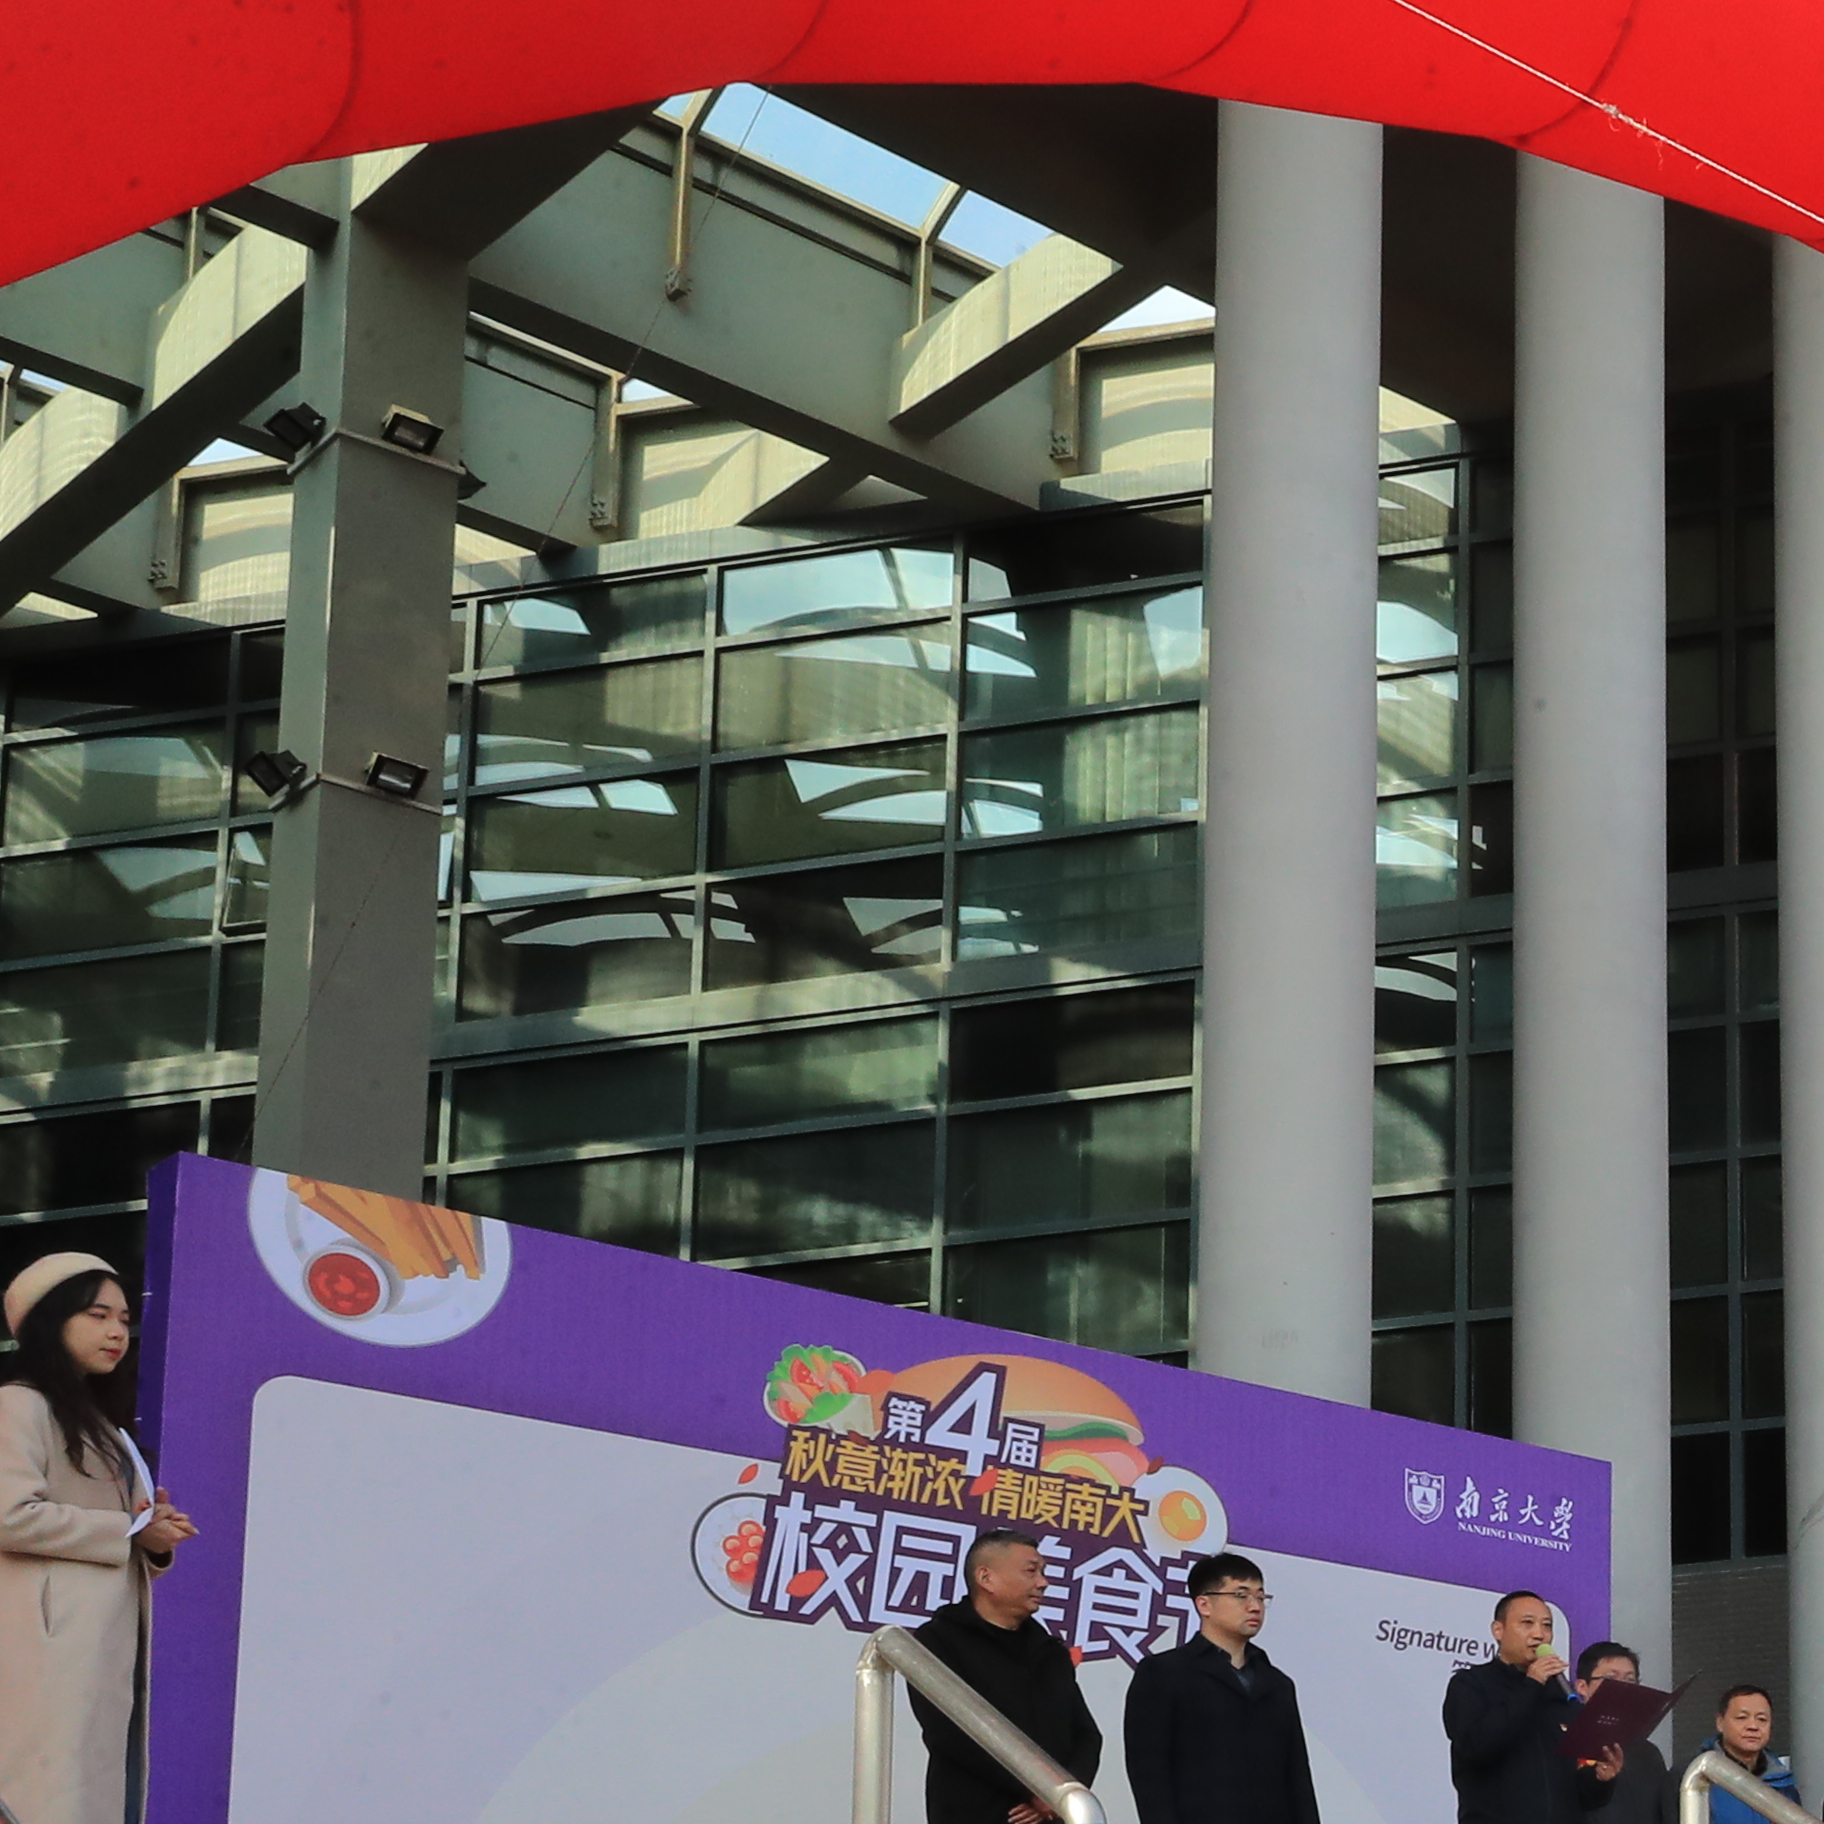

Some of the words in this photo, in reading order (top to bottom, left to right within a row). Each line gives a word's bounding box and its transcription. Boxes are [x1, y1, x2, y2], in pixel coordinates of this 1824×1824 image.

[885, 1371, 1042, 1477] 第4届
[785, 1429, 967, 1511] 秋意渐浓
[980, 1463, 1149, 1545] 情暖南大
[1457, 1520, 1507, 1541] NANJING
[1507, 1530, 1573, 1553] UNIVERSITY
[1375, 1619, 1479, 1652] Signature
